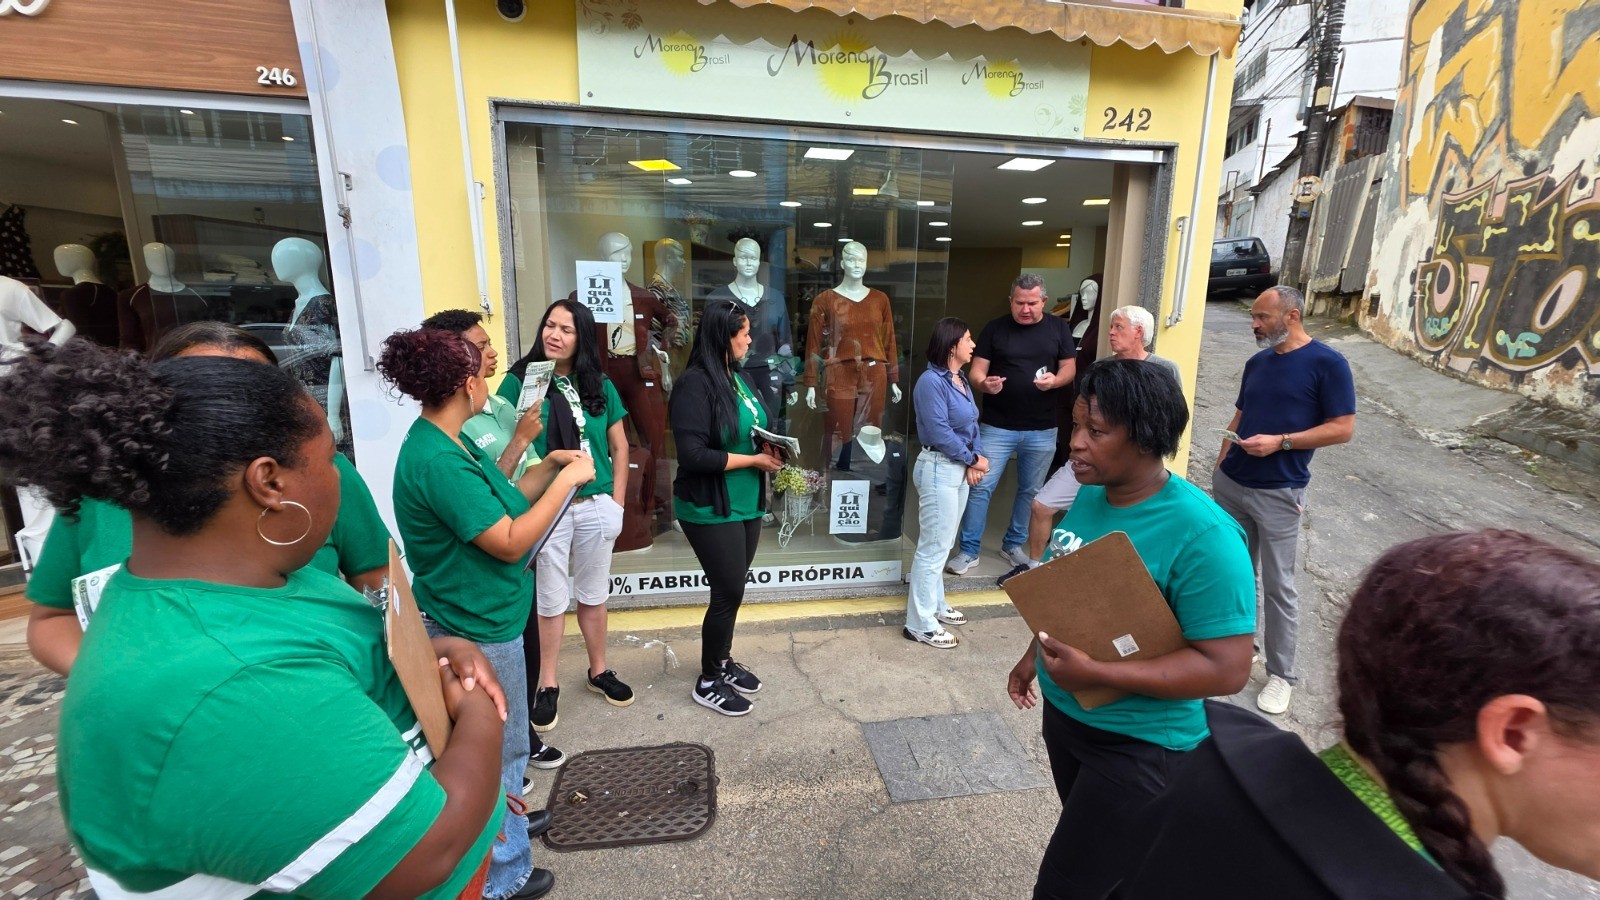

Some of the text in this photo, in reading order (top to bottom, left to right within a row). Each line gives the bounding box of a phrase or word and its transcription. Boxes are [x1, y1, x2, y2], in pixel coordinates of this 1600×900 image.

[634, 33, 730, 72] Morena Brasil
[766, 34, 928, 100] Morena Brasil
[256, 65, 297, 87] 246
[961, 62, 1045, 97] Morena Brasil
[1102, 106, 1152, 132] 242
[589, 278, 610, 289] LI
[587, 296, 613, 305] DA
[588, 289, 612, 297] qui
[841, 496, 859, 504] LI
[838, 518, 860, 526] ção
[778, 566, 864, 583] PRÓPRIA
